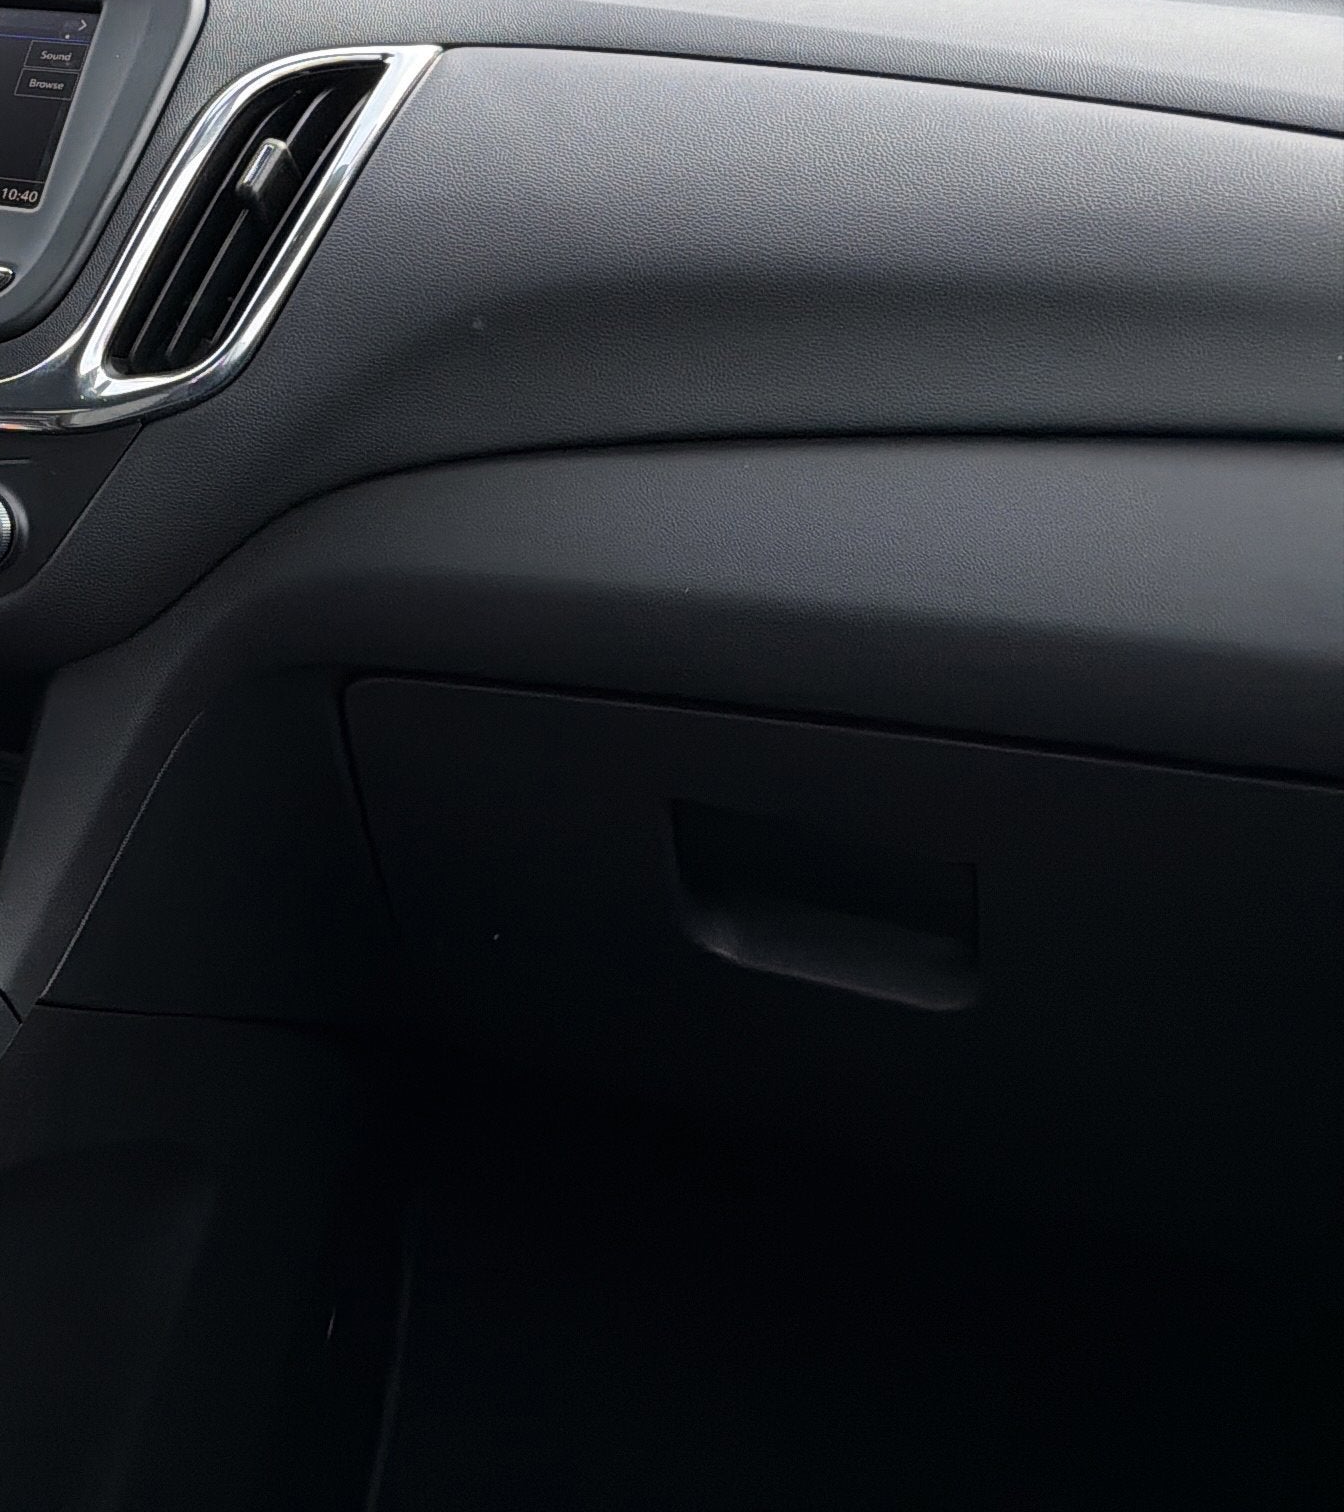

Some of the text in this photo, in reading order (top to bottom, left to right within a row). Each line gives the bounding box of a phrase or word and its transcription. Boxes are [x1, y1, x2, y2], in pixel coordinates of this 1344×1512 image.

[40, 50, 73, 62] Sound
[28, 78, 65, 91] Browse
[1, 187, 39, 203] 10:40
